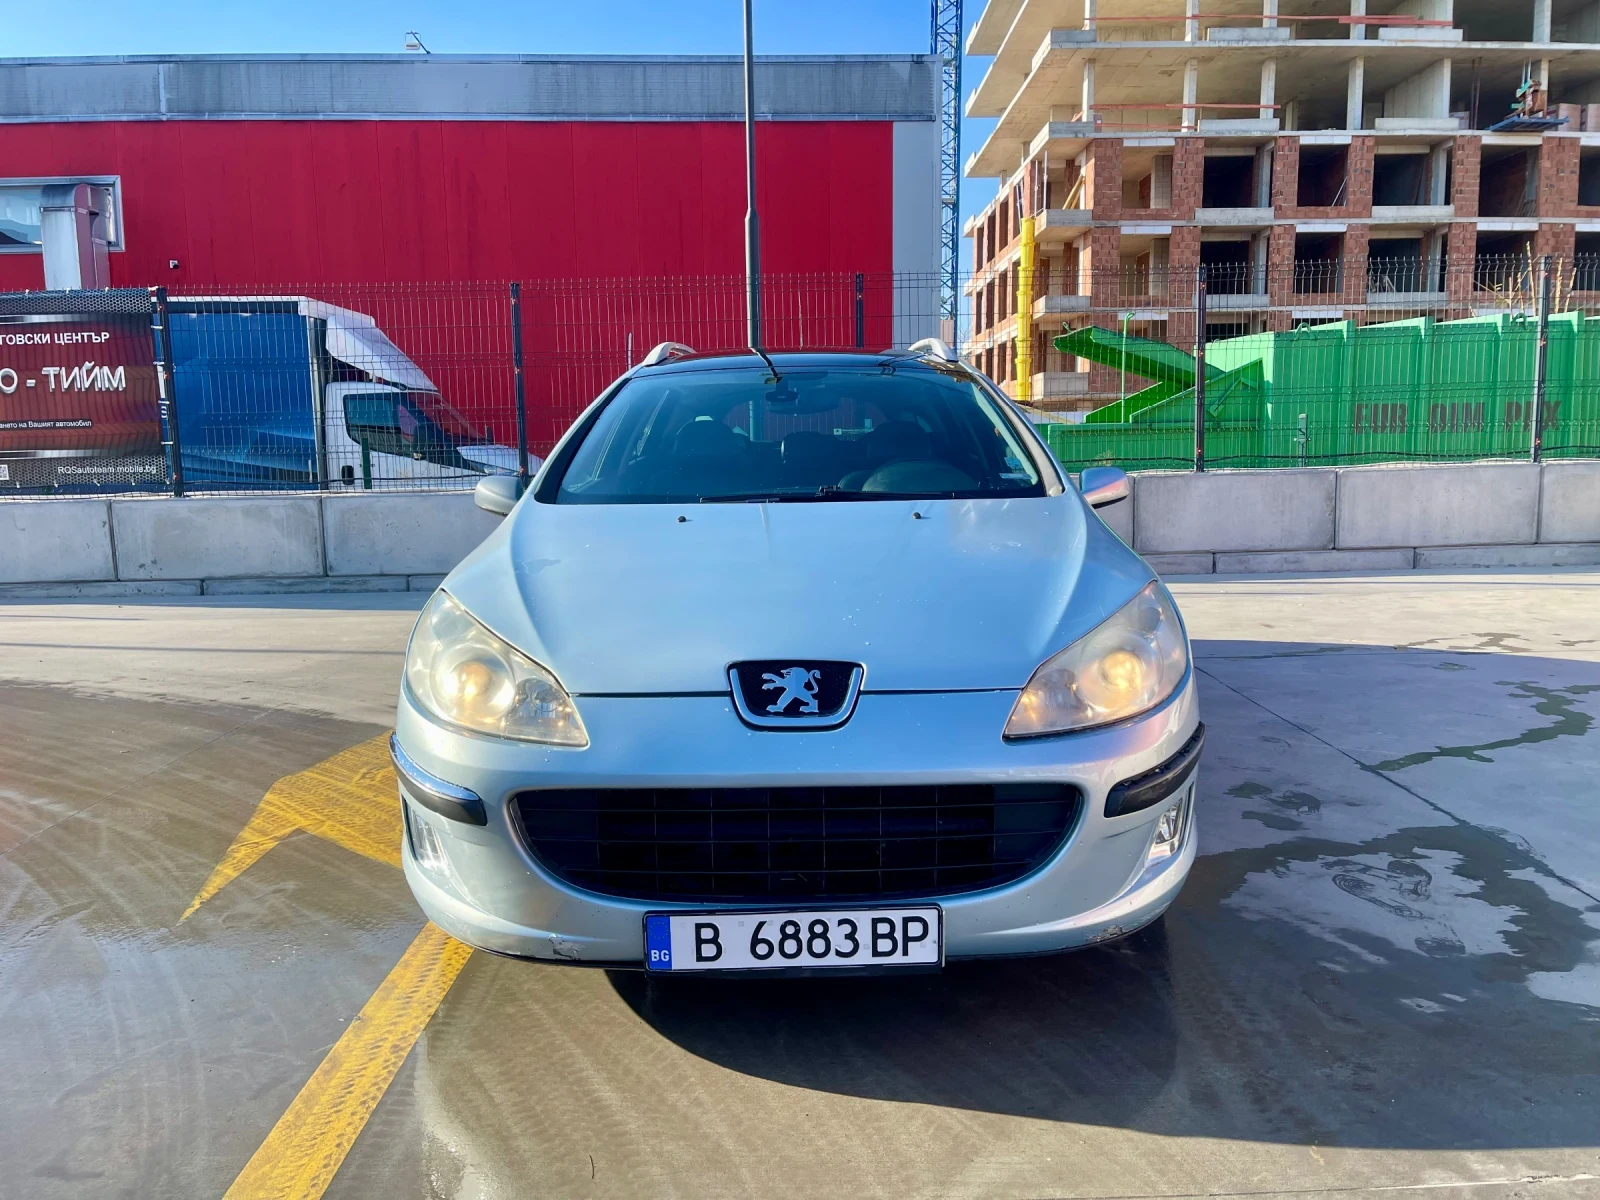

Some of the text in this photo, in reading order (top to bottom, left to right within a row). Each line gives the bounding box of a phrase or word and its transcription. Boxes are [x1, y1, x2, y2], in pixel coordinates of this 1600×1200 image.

[54, 332, 110, 345] ЦЕНТЪР
[41, 361, 126, 392] ТИЙМ
[28, 420, 54, 428] Вашият
[55, 419, 92, 427] автомобил
[694, 916, 929, 963] B 6883 BP
[651, 950, 670, 962] BG
